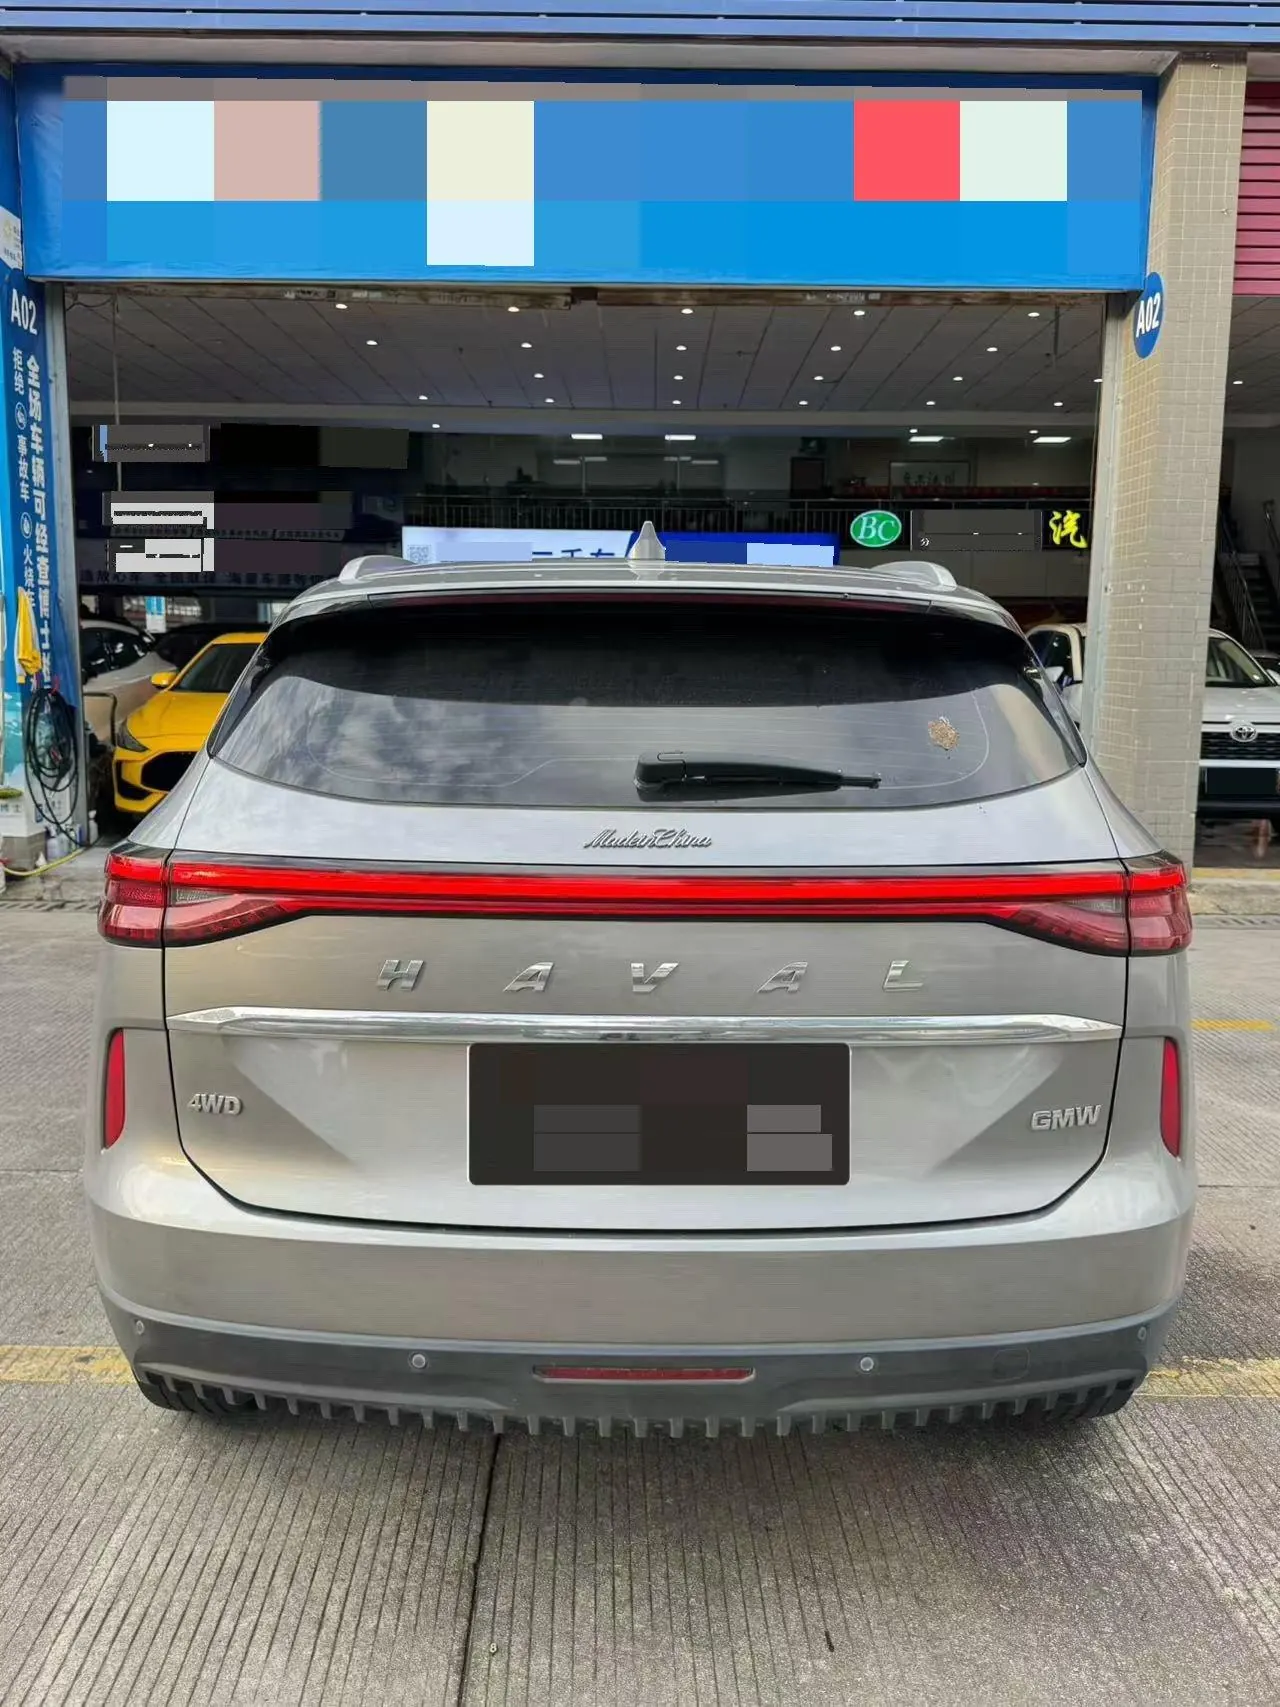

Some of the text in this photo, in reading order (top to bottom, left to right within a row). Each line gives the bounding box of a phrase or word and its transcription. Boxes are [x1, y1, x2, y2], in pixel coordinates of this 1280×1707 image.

[11, 287, 37, 335] A02
[1135, 292, 1161, 338] A02
[12, 346, 25, 396] 拒绝
[17, 434, 30, 503] 事故车
[857, 515, 896, 542] BC
[376, 959, 924, 993] HAVAL
[187, 1092, 242, 1115] 4WD
[1031, 1104, 1102, 1131] GMW
